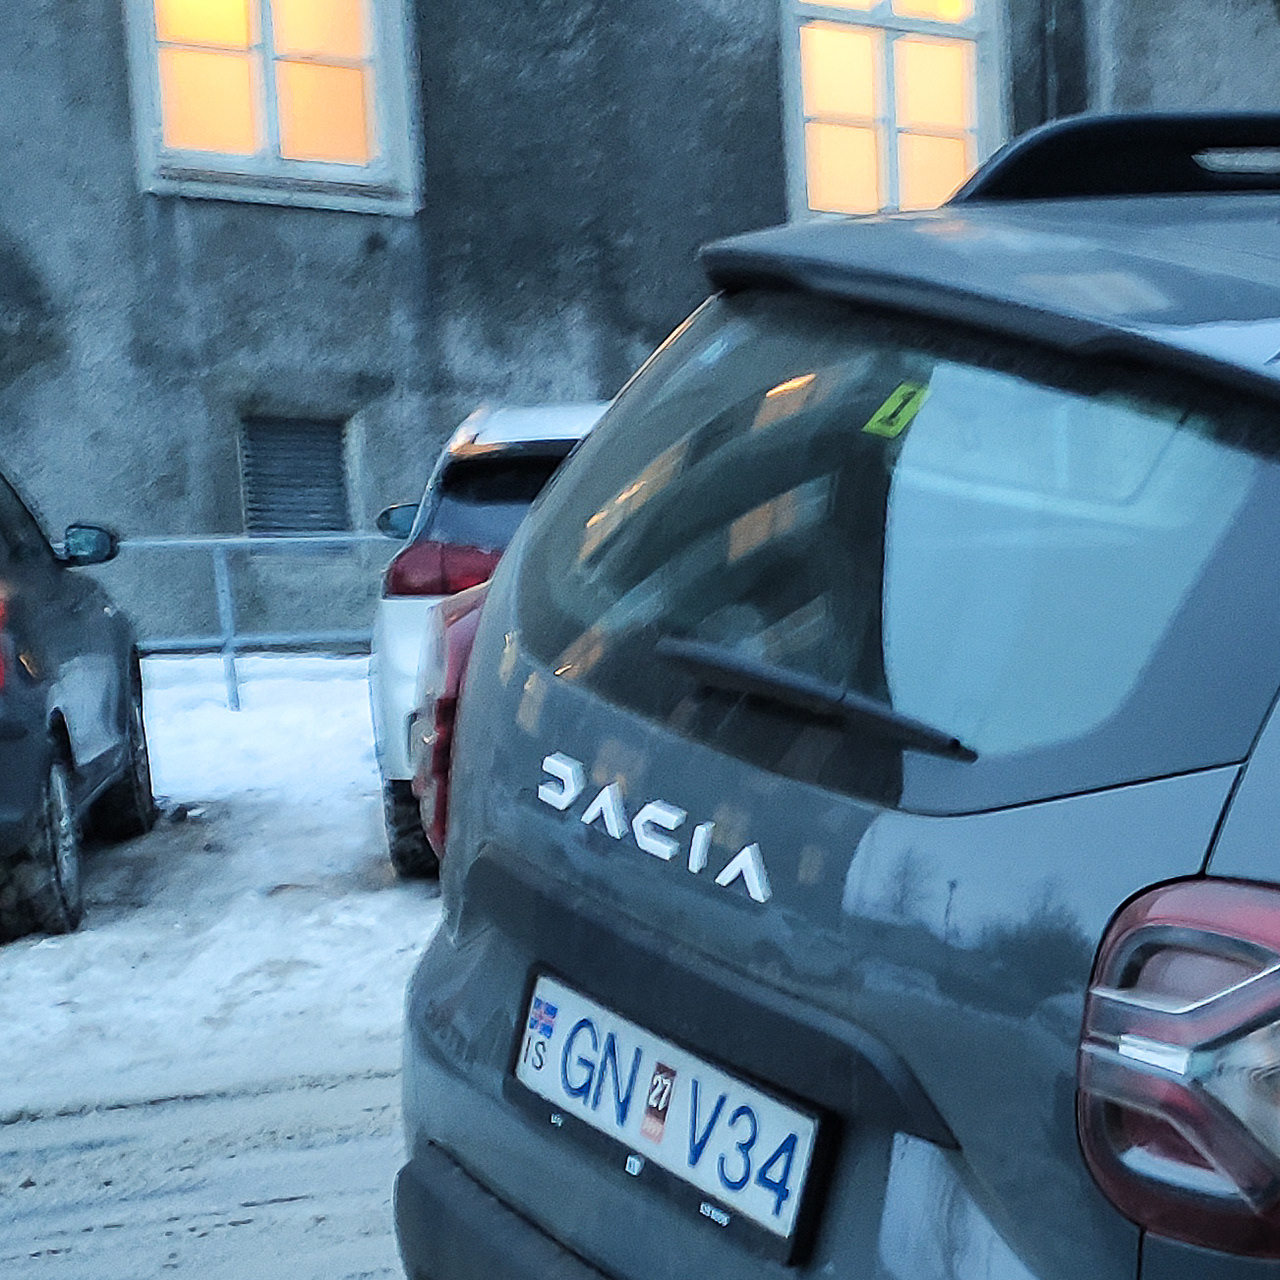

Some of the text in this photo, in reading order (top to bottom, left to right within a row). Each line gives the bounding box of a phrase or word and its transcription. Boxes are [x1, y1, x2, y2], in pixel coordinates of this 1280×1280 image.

[538, 751, 773, 903] DACIA
[523, 1036, 547, 1071] IS
[560, 1018, 799, 1217] GN V34
